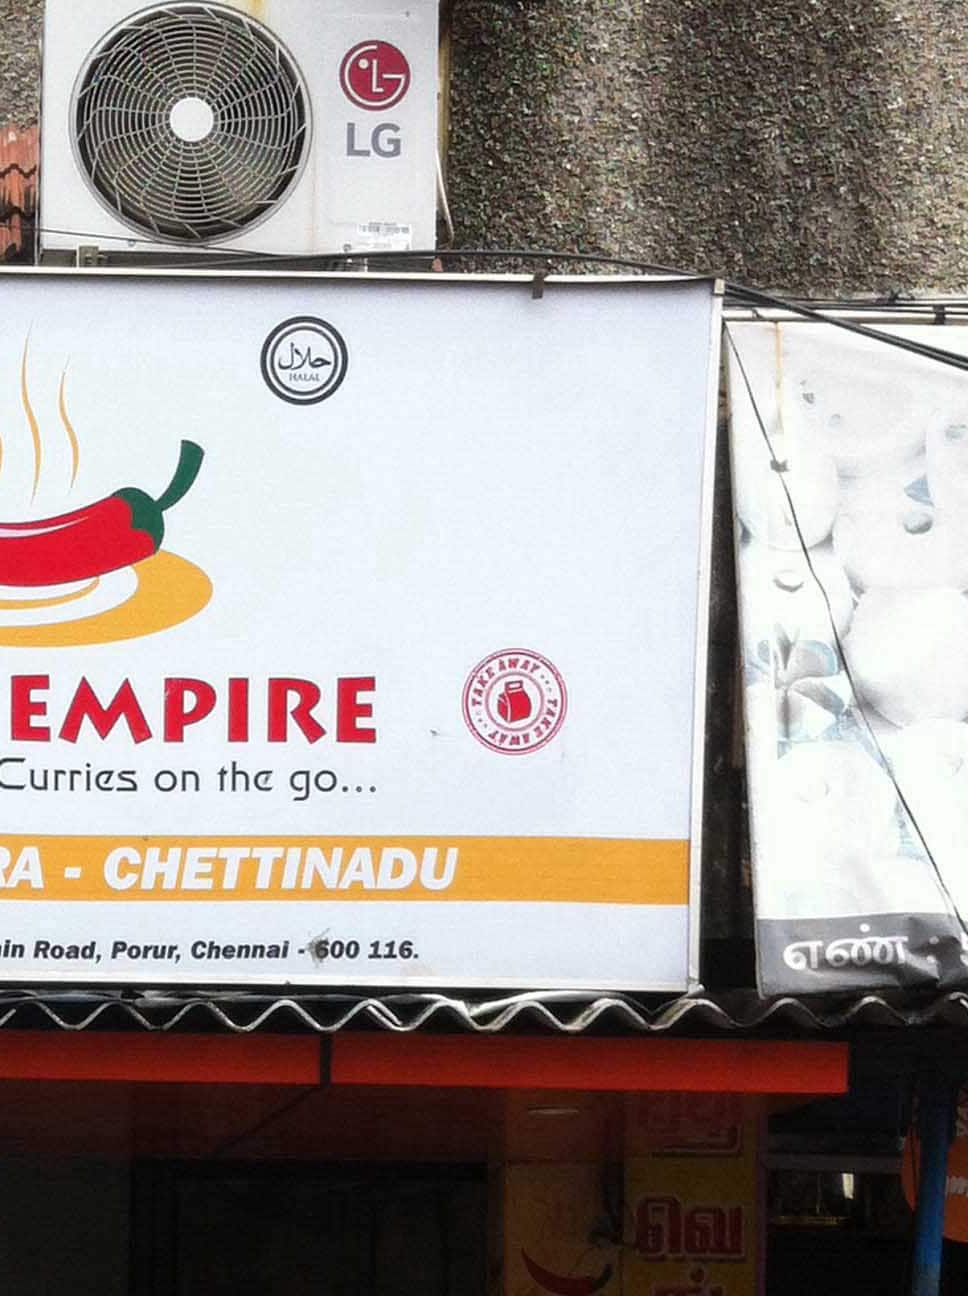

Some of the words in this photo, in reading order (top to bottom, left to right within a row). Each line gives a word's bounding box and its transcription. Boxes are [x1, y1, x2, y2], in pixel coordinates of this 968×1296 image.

[346, 122, 402, 158] LG
[278, 342, 332, 370] حلال
[289, 372, 321, 382] HALAL
[471, 667, 495, 706] TAKE
[498, 657, 541, 673] AWAY
[10, 674, 377, 745] EMPIRE
[534, 698, 558, 739] TAKE
[487, 730, 530, 746] AWAY
[154, 769, 200, 793] on
[218, 761, 273, 793] the
[289, 769, 377, 802] go...
[103, 846, 459, 891] CHETTINADU
[33, 940, 102, 963] Road,
[111, 941, 181, 963] Porur,
[191, 941, 290, 960] Chennai
[314, 941, 360, 960] 600
[368, 941, 420, 960] 116.
[783, 923, 909, 972] எண்
